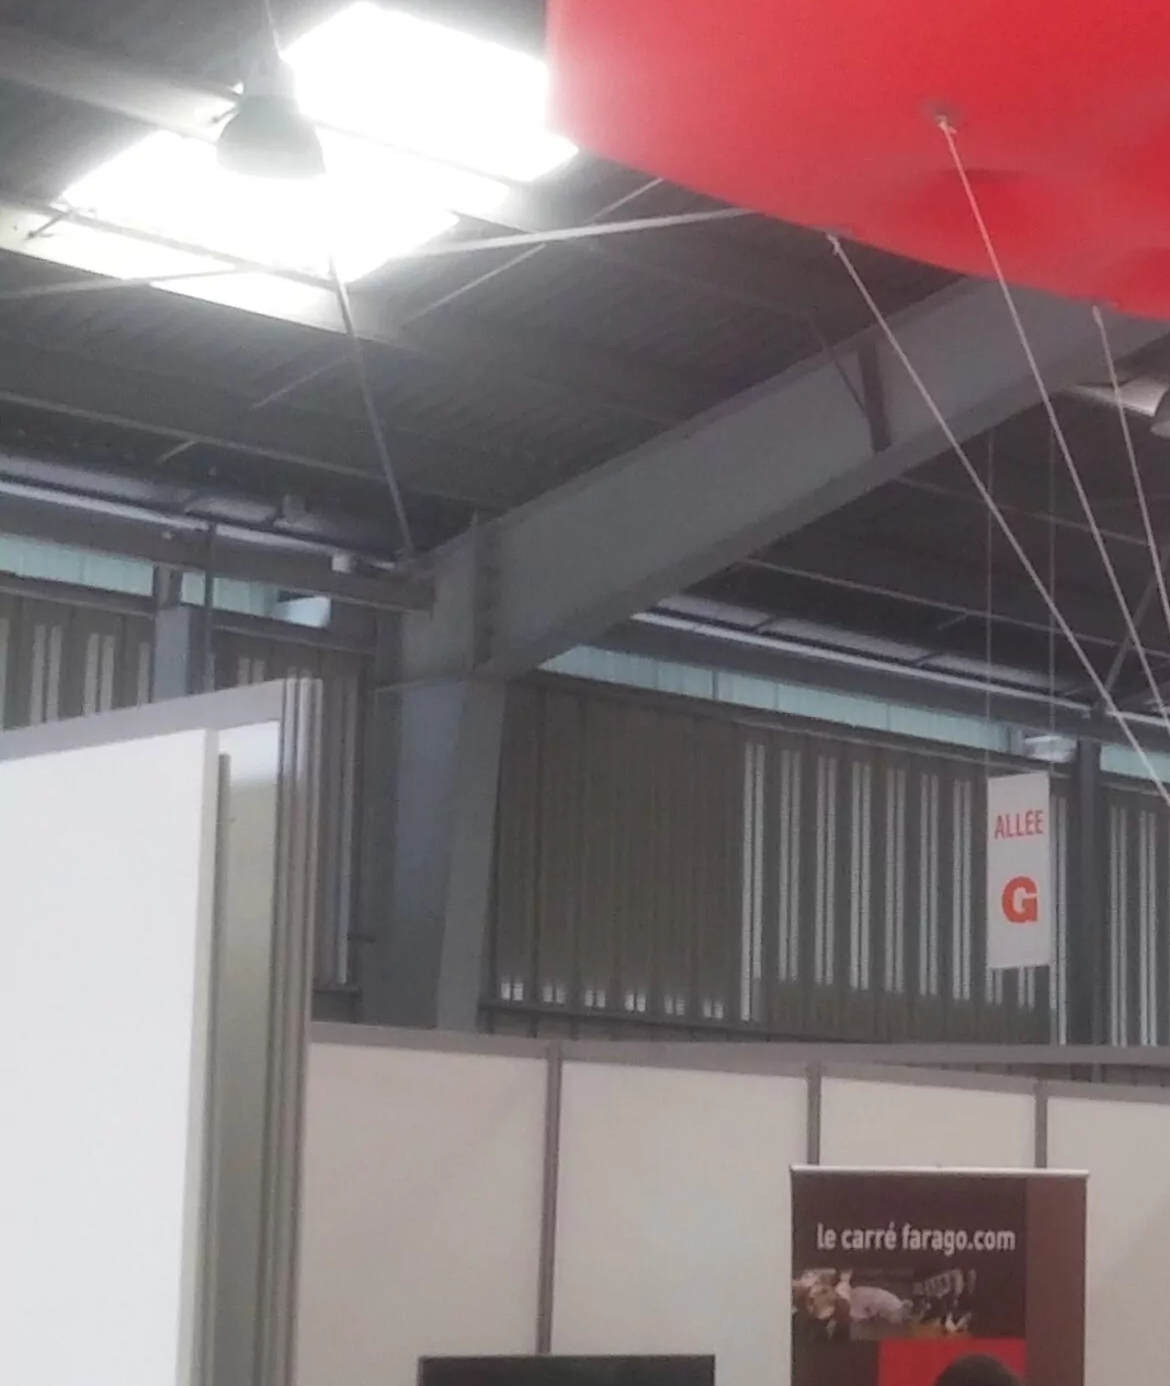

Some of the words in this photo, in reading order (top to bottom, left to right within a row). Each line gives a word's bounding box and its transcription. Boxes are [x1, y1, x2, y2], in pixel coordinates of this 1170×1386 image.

[1001, 875, 1038, 924] G
[817, 1223, 837, 1250] le
[841, 1221, 897, 1250] carré
[902, 1223, 1016, 1256] farago.com
